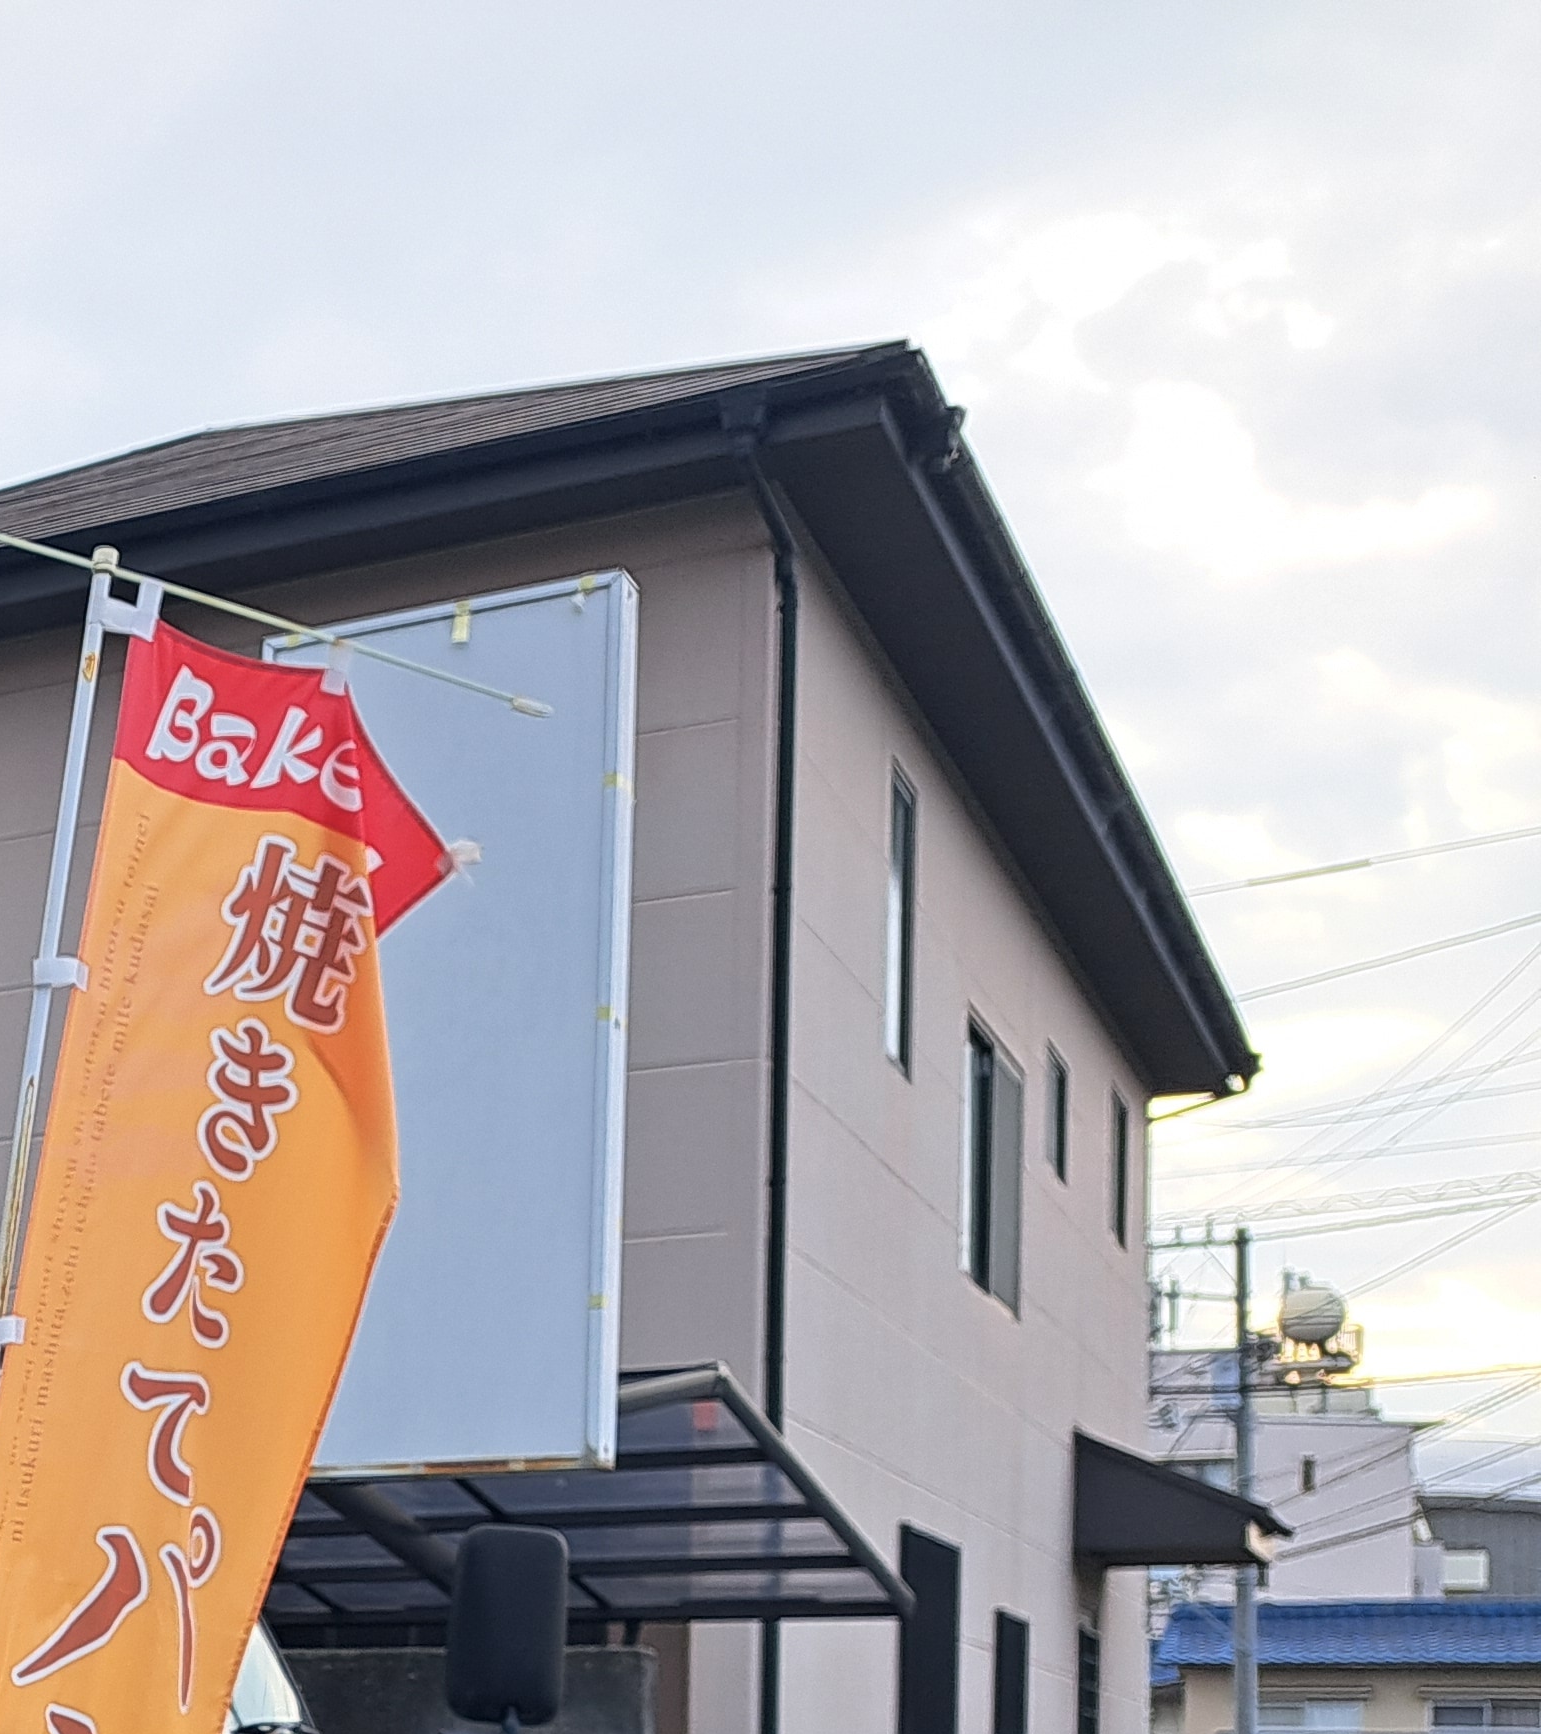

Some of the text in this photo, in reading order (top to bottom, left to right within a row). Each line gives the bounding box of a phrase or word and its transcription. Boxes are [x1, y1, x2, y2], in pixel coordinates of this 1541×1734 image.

[18, 1419, 45, 1509] tsukuri
[92, 1056, 119, 1143] tabete
[112, 994, 133, 1053] mite
[127, 880, 160, 990] kudasai
